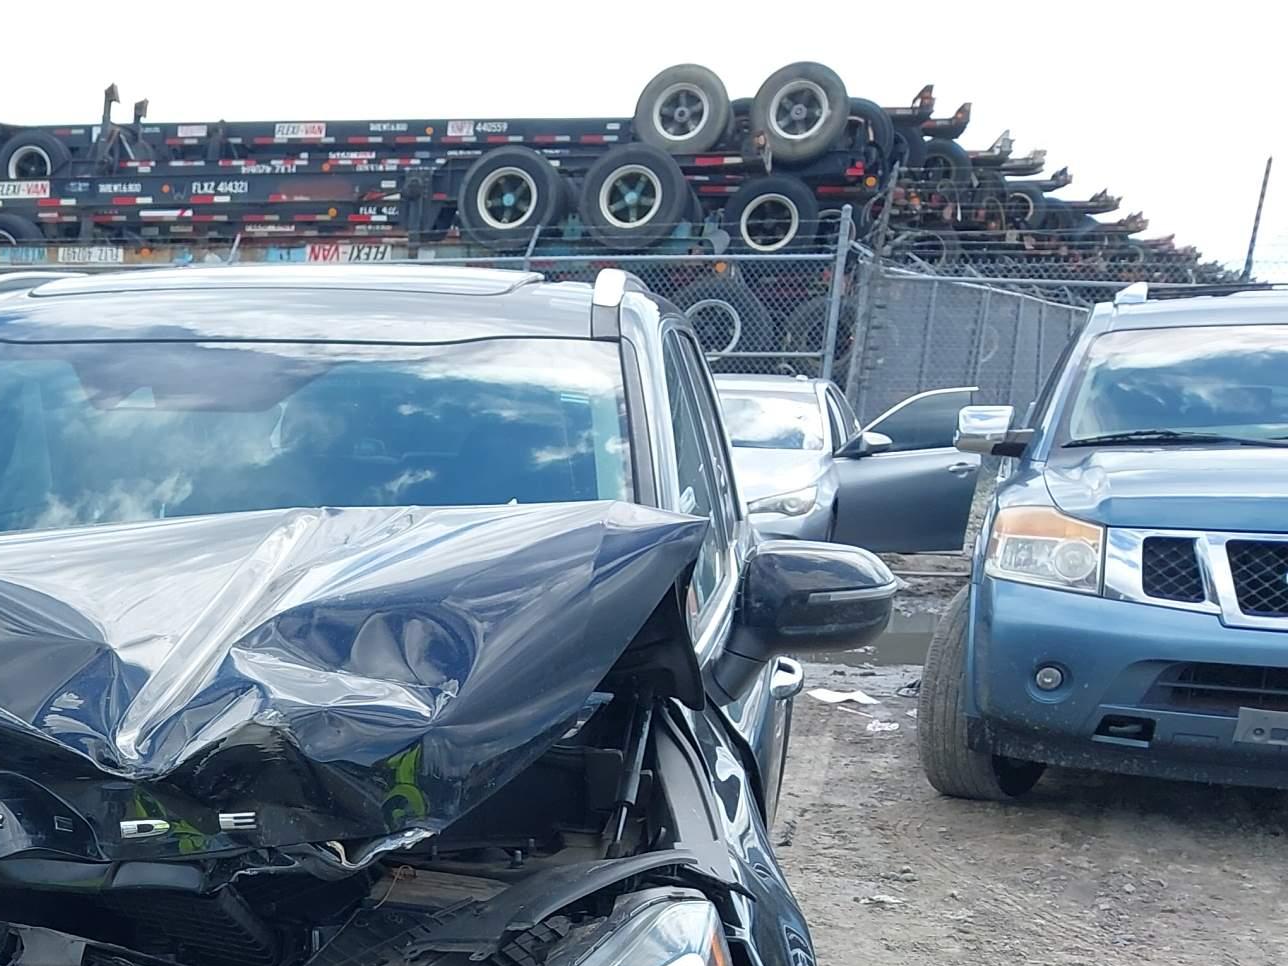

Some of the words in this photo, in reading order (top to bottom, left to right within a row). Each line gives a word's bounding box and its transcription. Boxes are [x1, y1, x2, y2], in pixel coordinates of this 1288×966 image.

[277, 124, 324, 137] FLEXI-VAN
[192, 181, 216, 194] FLXZ
[309, 244, 386, 263] FLEXI-VAN
